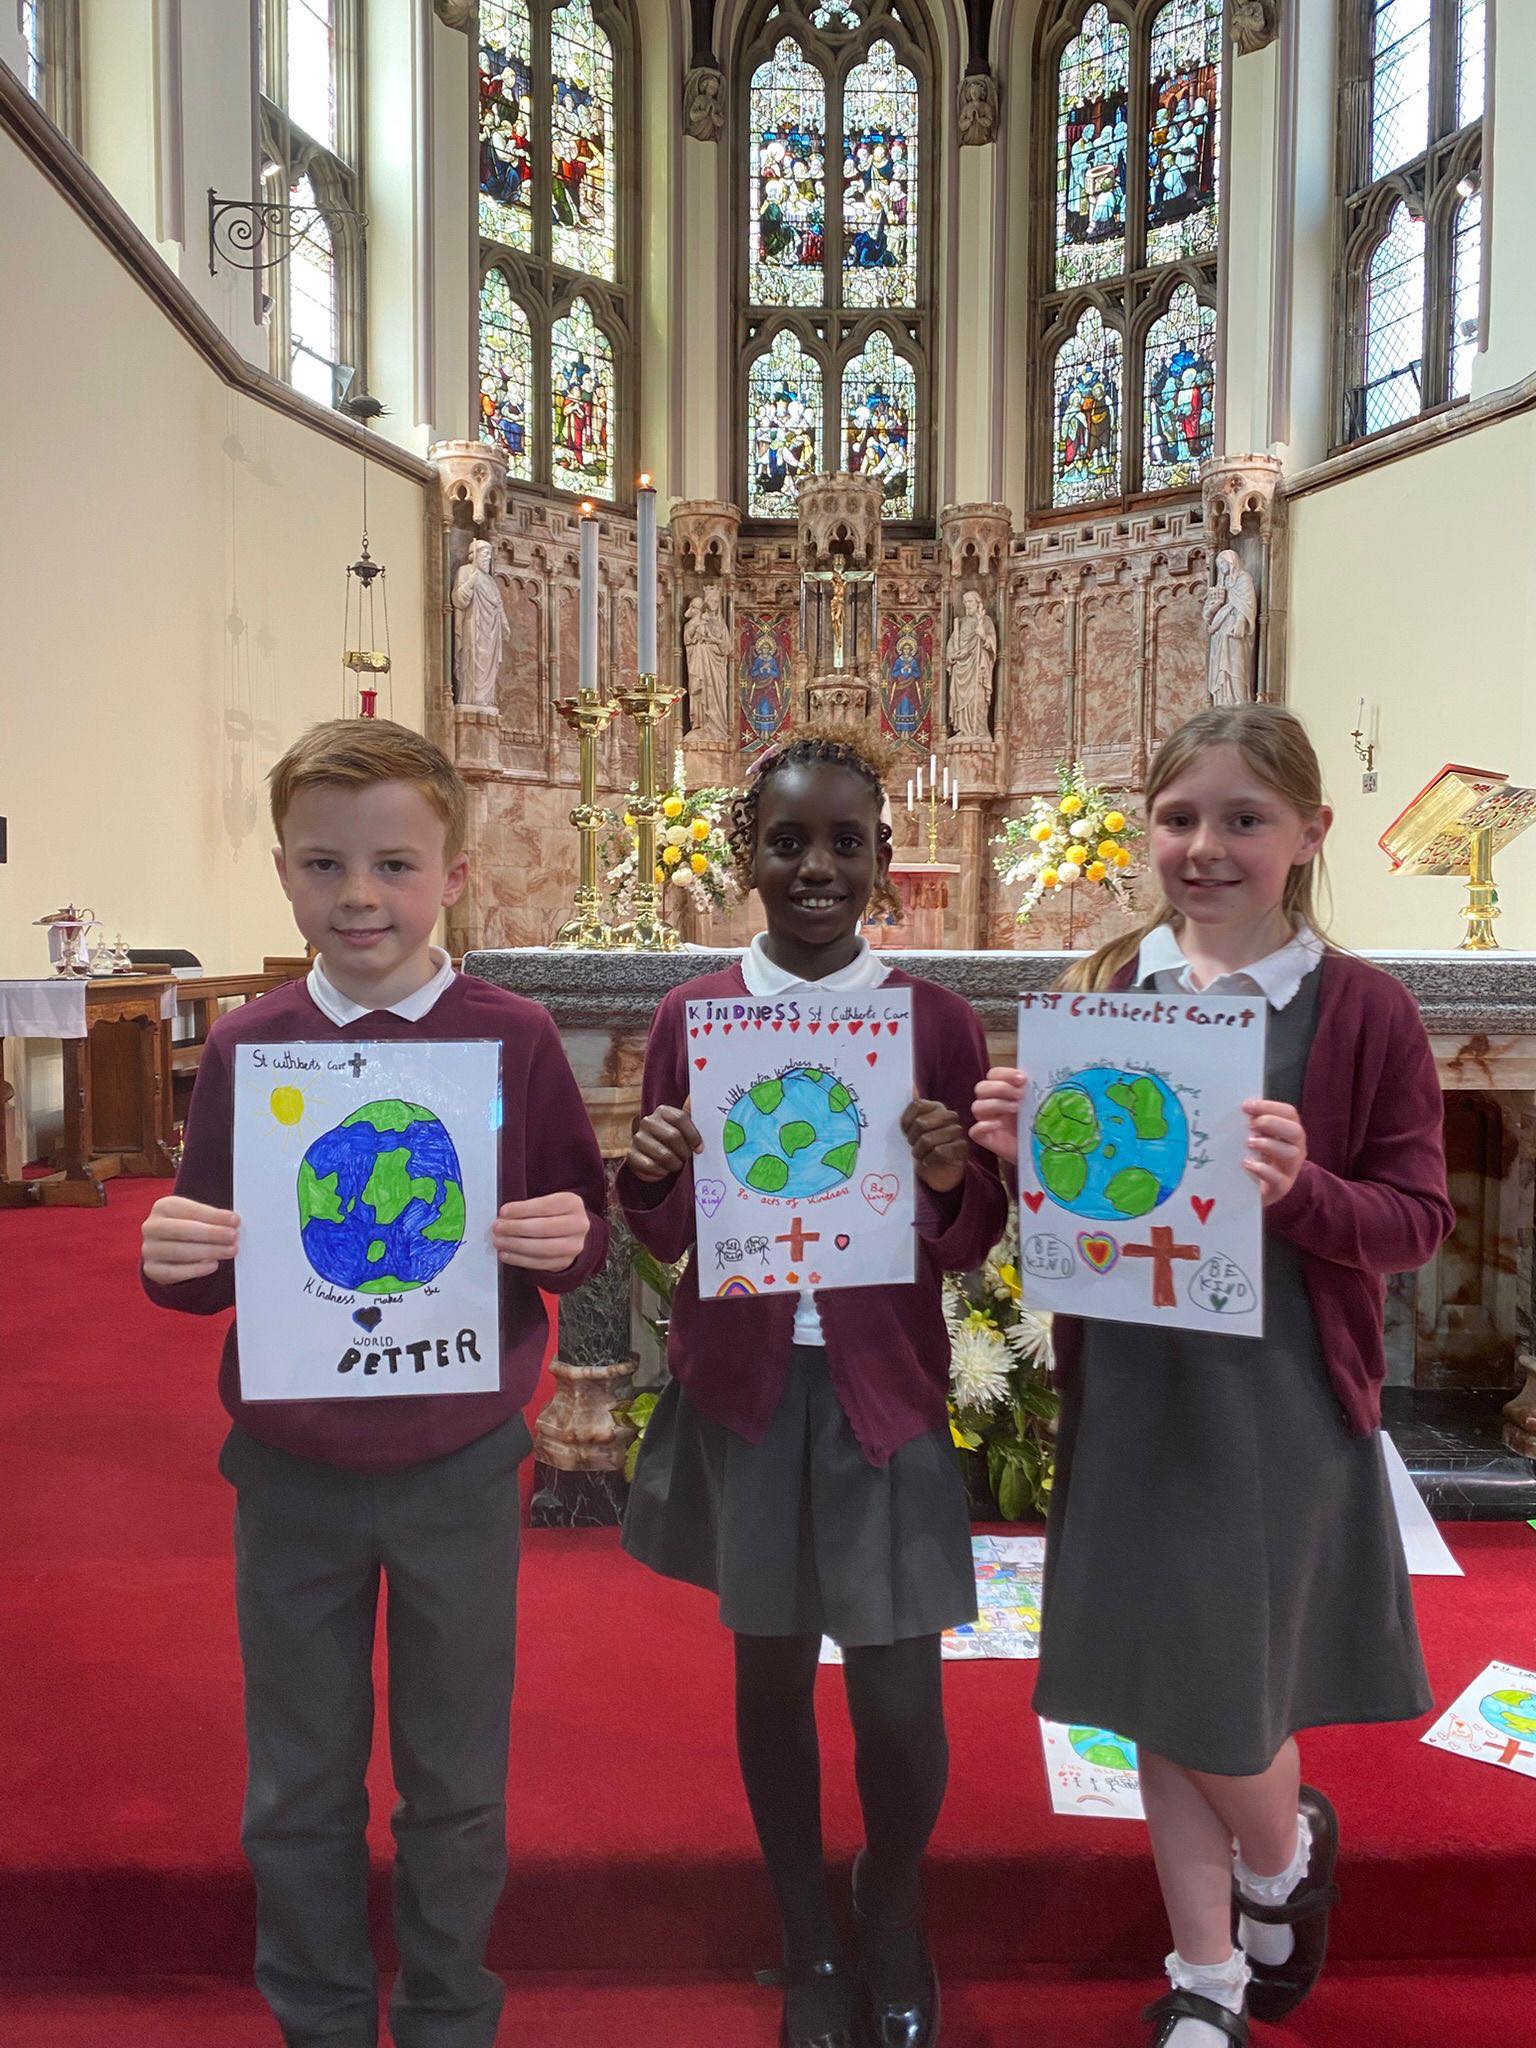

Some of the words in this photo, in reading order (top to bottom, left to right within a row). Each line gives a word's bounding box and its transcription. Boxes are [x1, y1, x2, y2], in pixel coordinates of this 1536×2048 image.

[808, 1006, 822, 1021] St
[830, 1006, 876, 1020] Cuthberts
[883, 1006, 910, 1020] Care
[253, 1049, 267, 1068] St
[1034, 1236, 1059, 1257] BE
[1208, 1257, 1238, 1278] BE
[303, 1277, 355, 1304] Kindness
[374, 1293, 403, 1305] makes
[424, 1286, 440, 1296] the
[1199, 1275, 1247, 1297] KIND
[353, 1336, 393, 1347] WORLD
